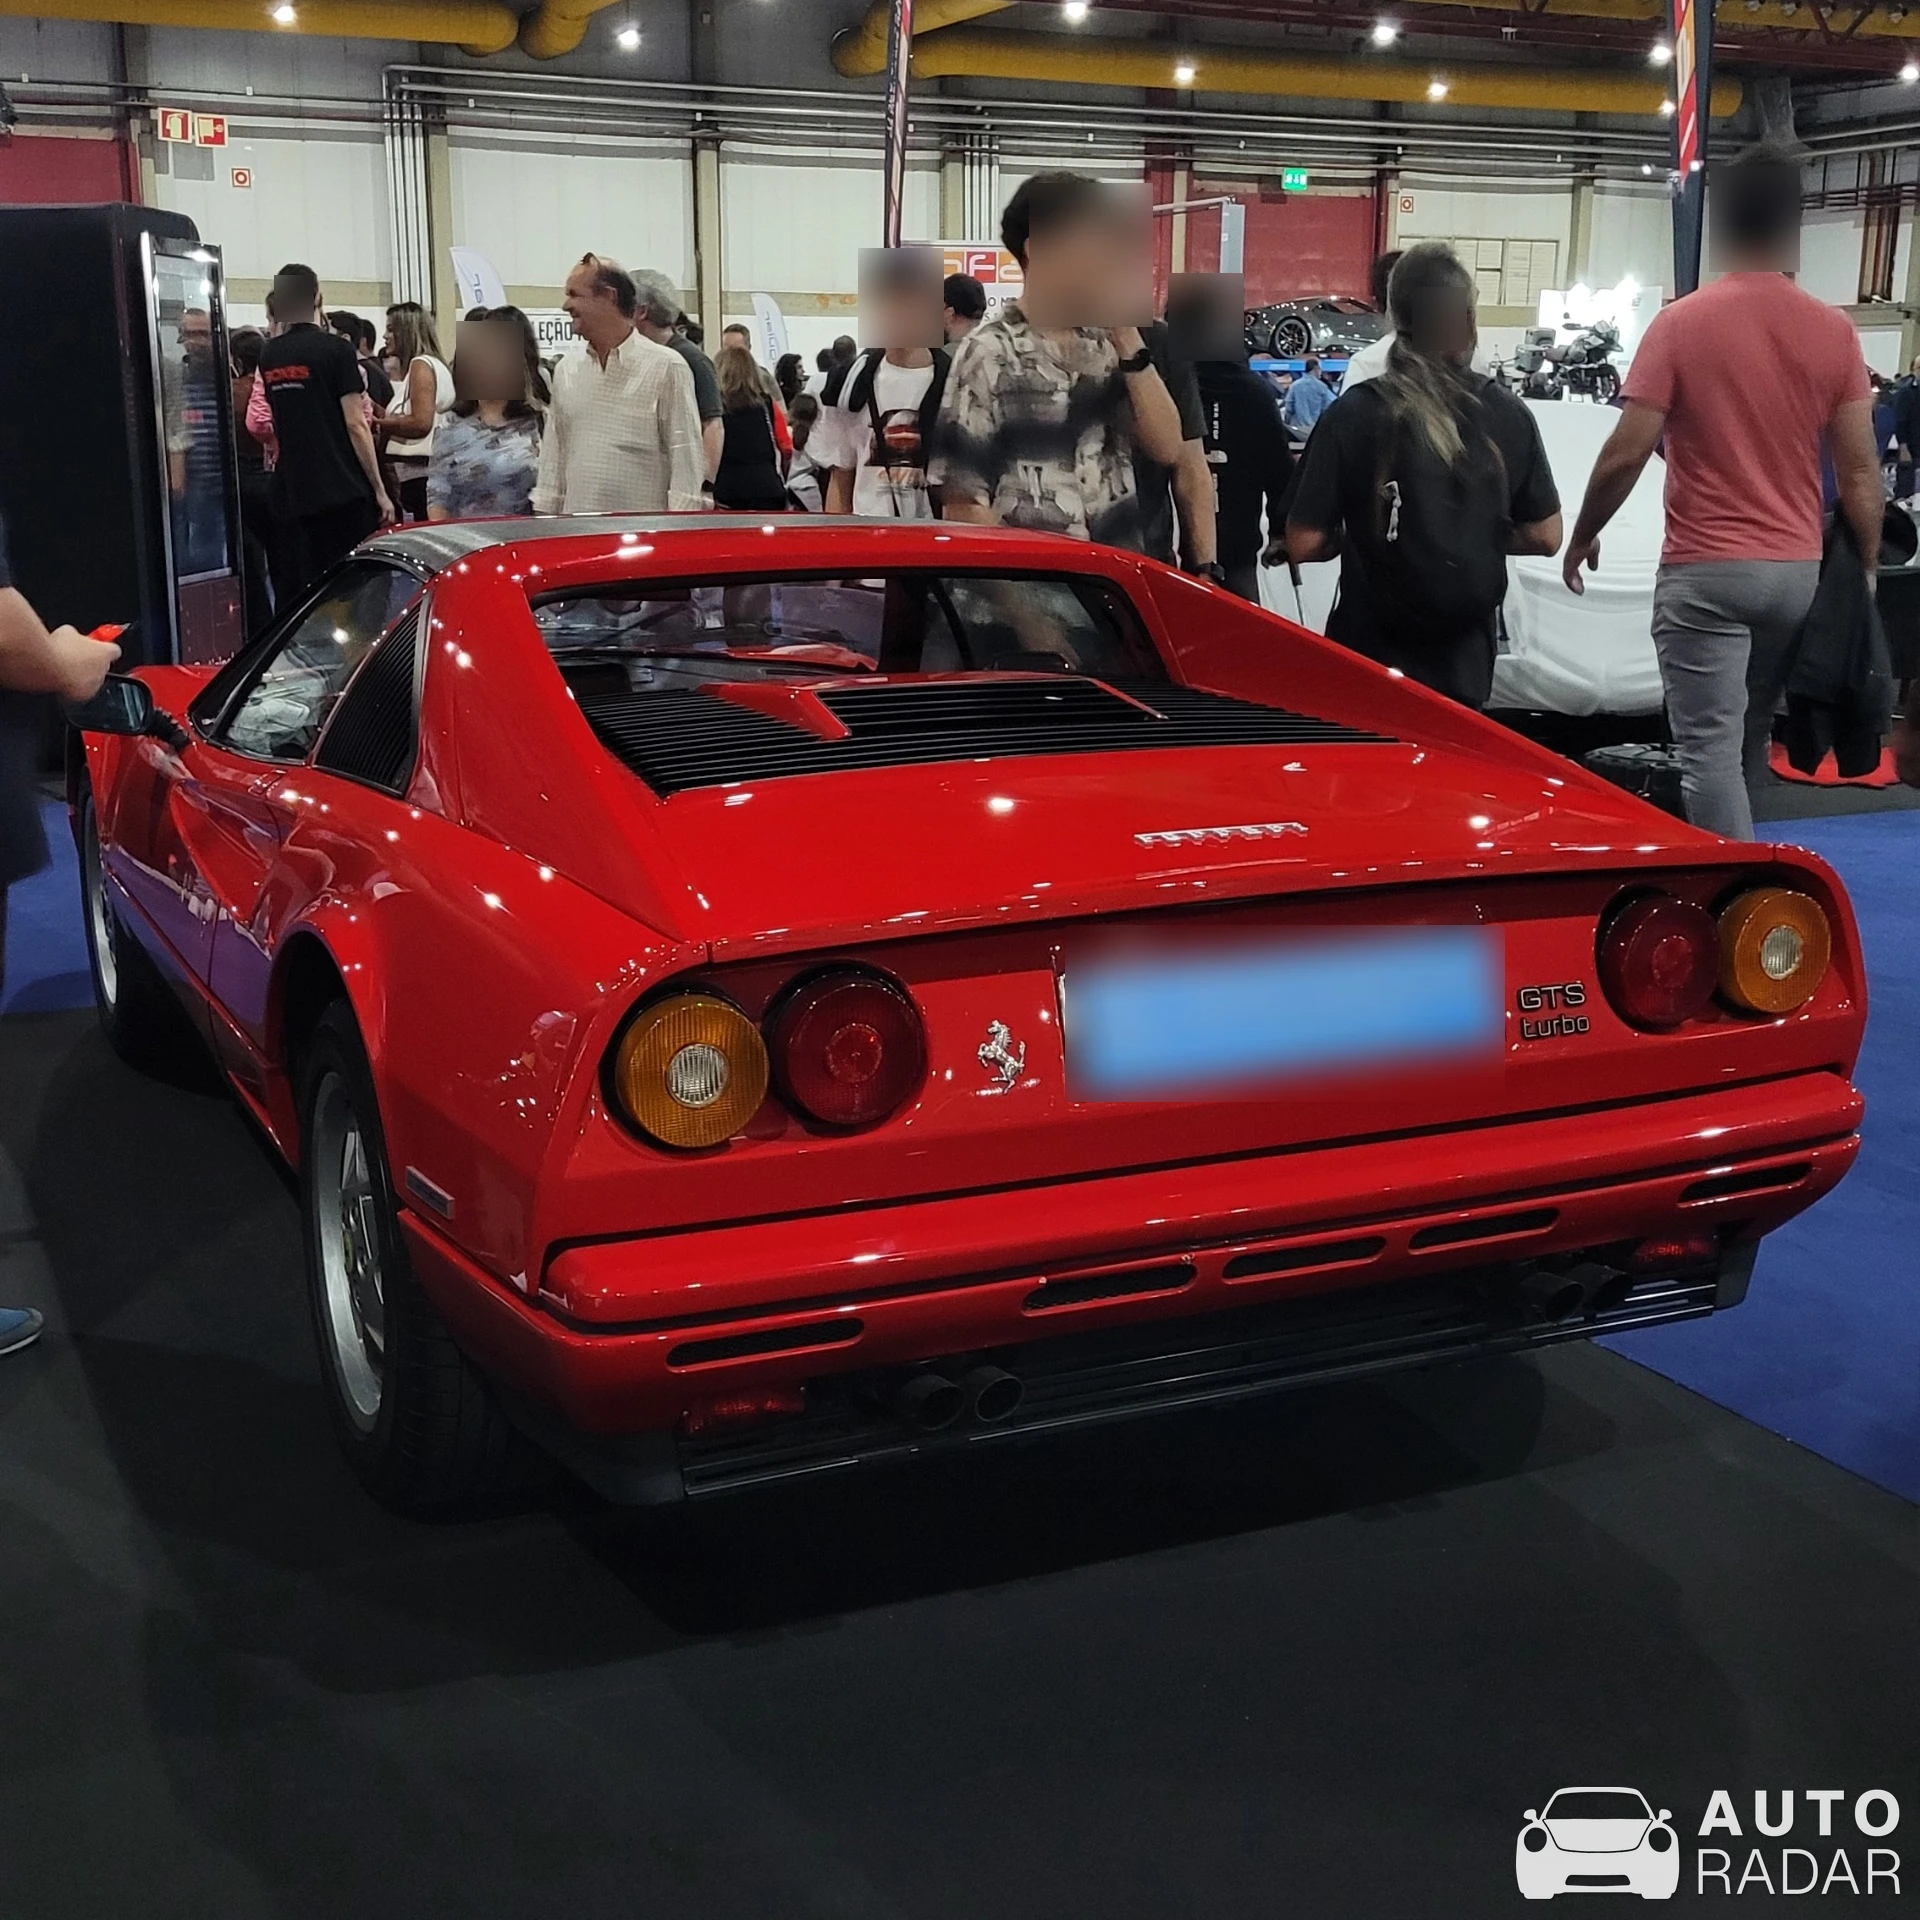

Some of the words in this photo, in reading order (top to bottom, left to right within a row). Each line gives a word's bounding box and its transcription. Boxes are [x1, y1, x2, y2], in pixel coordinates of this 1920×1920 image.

[531, 318, 573, 346] EÇÃO
[1520, 983, 1585, 1009] GTS
[1523, 1015, 1590, 1038] turbo
